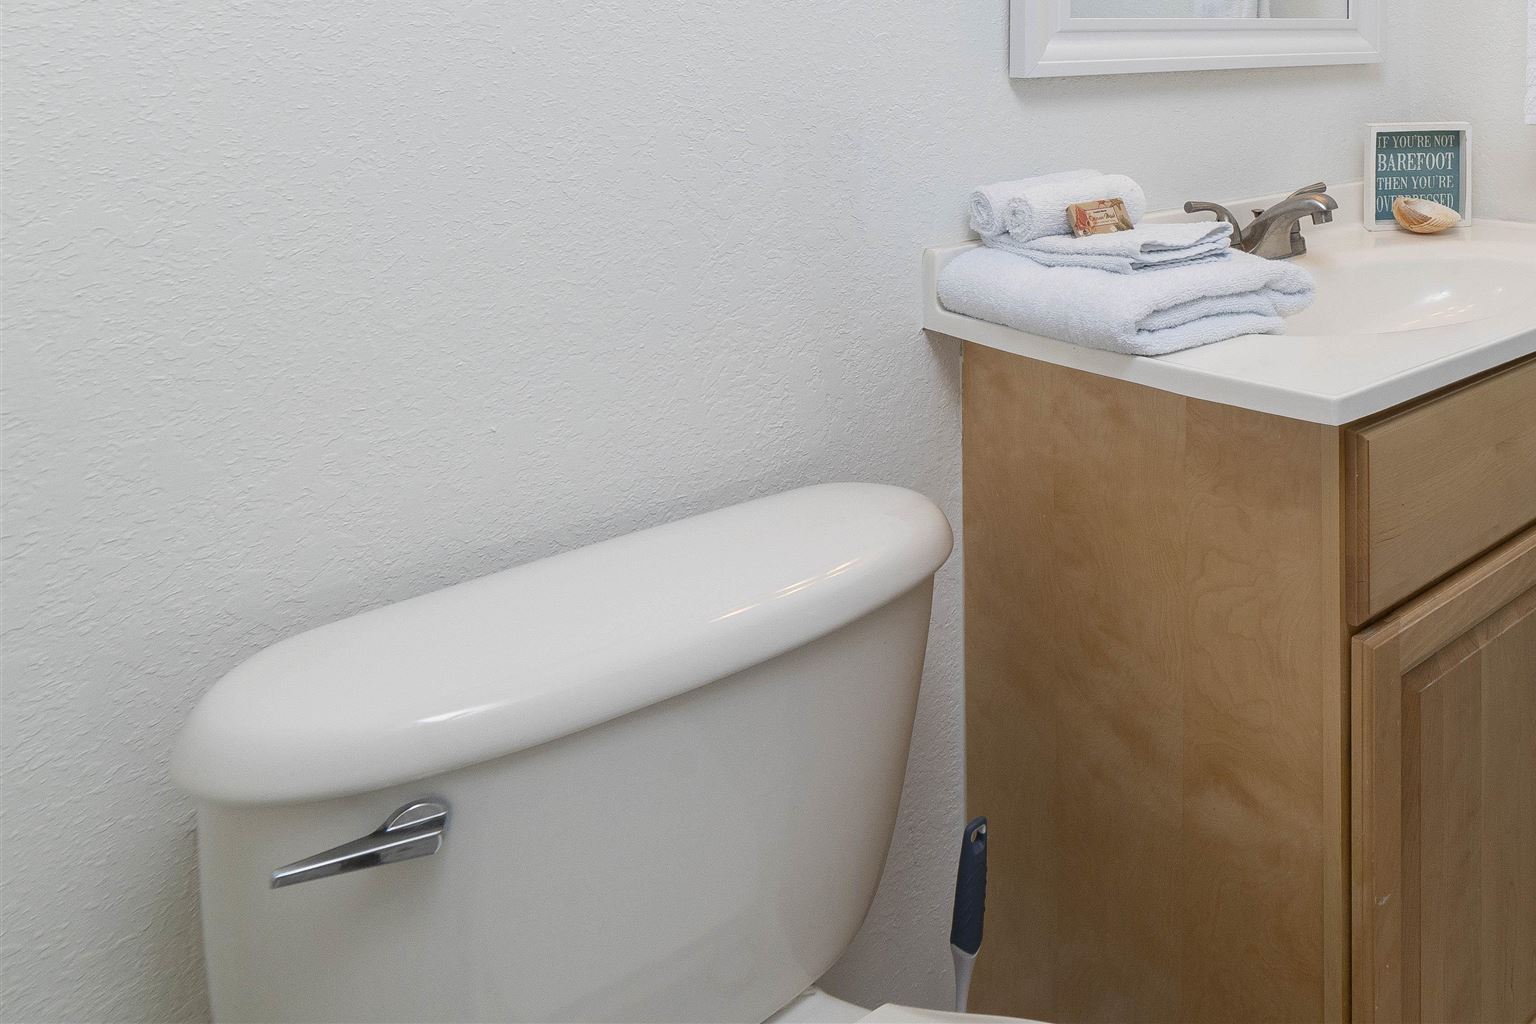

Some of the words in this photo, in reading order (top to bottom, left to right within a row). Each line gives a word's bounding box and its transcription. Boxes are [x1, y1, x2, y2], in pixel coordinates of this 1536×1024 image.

[1377, 136, 1390, 149] IF
[1392, 134, 1432, 149] YOU'RE
[1434, 134, 1456, 148] NOT
[1377, 152, 1455, 172] BAREFOOT
[1376, 176, 1408, 190] THEN
[1411, 174, 1455, 189] YOU'RE
